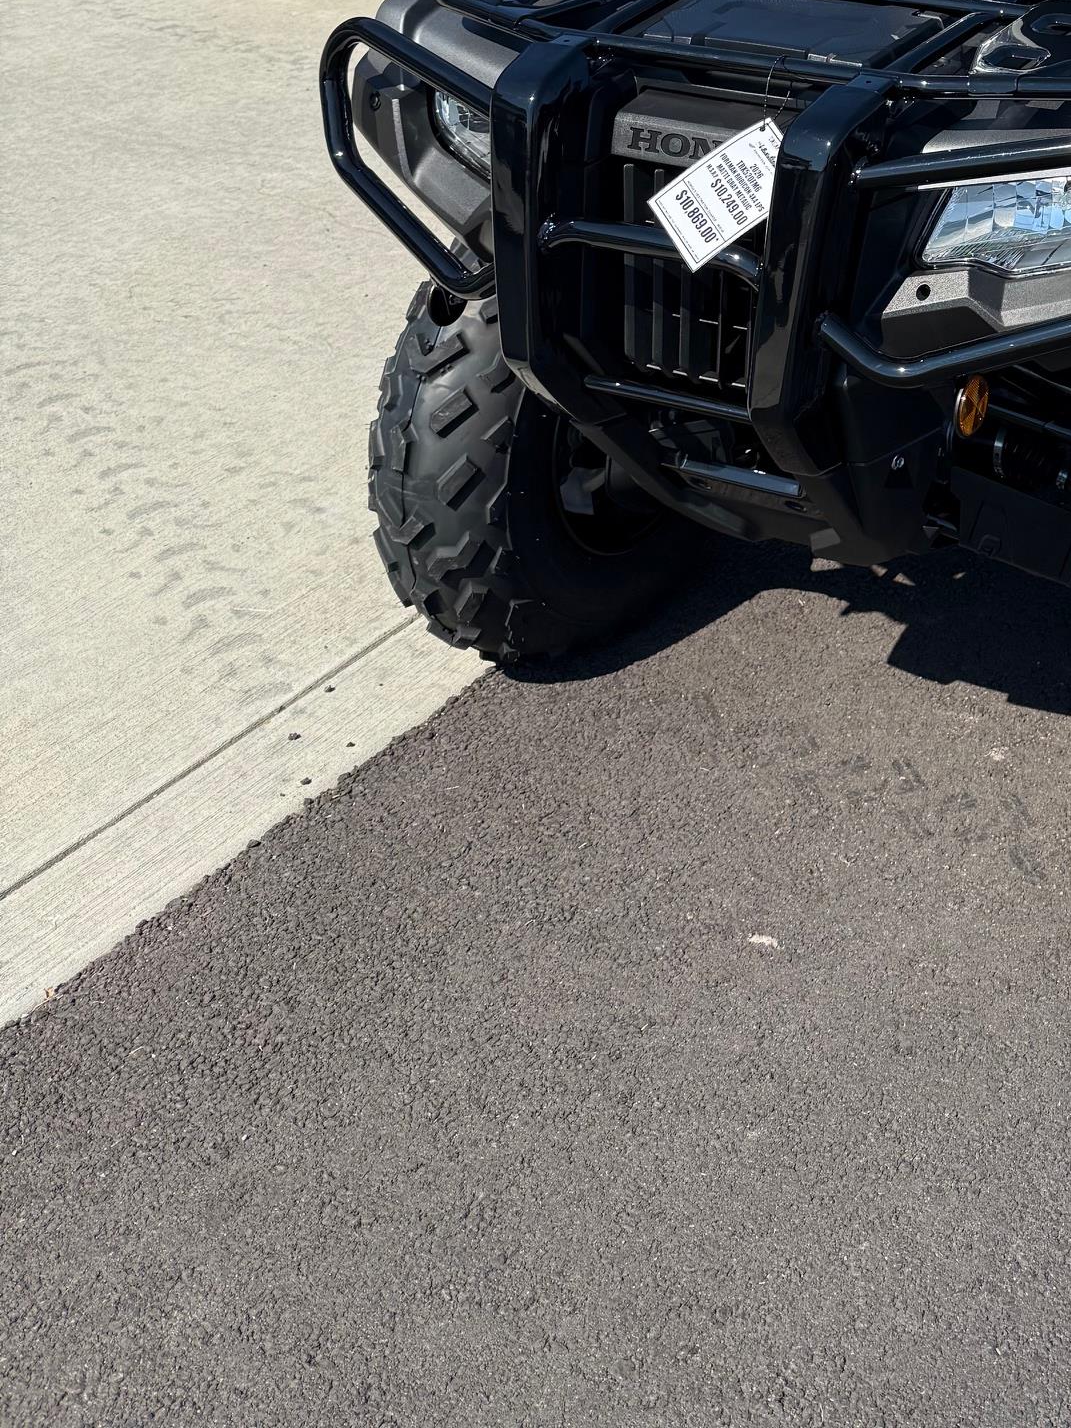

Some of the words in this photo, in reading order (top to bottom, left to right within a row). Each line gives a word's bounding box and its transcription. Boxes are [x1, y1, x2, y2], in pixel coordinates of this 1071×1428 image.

[627, 126, 722, 160] HON
[715, 162, 732, 182] MATTE
[726, 177, 740, 193] GRAY
[719, 152, 739, 177] FOREMAN
[734, 172, 753, 197] RUBICON
[748, 163, 765, 180] 2026
[710, 179, 748, 226] $10,249.00
